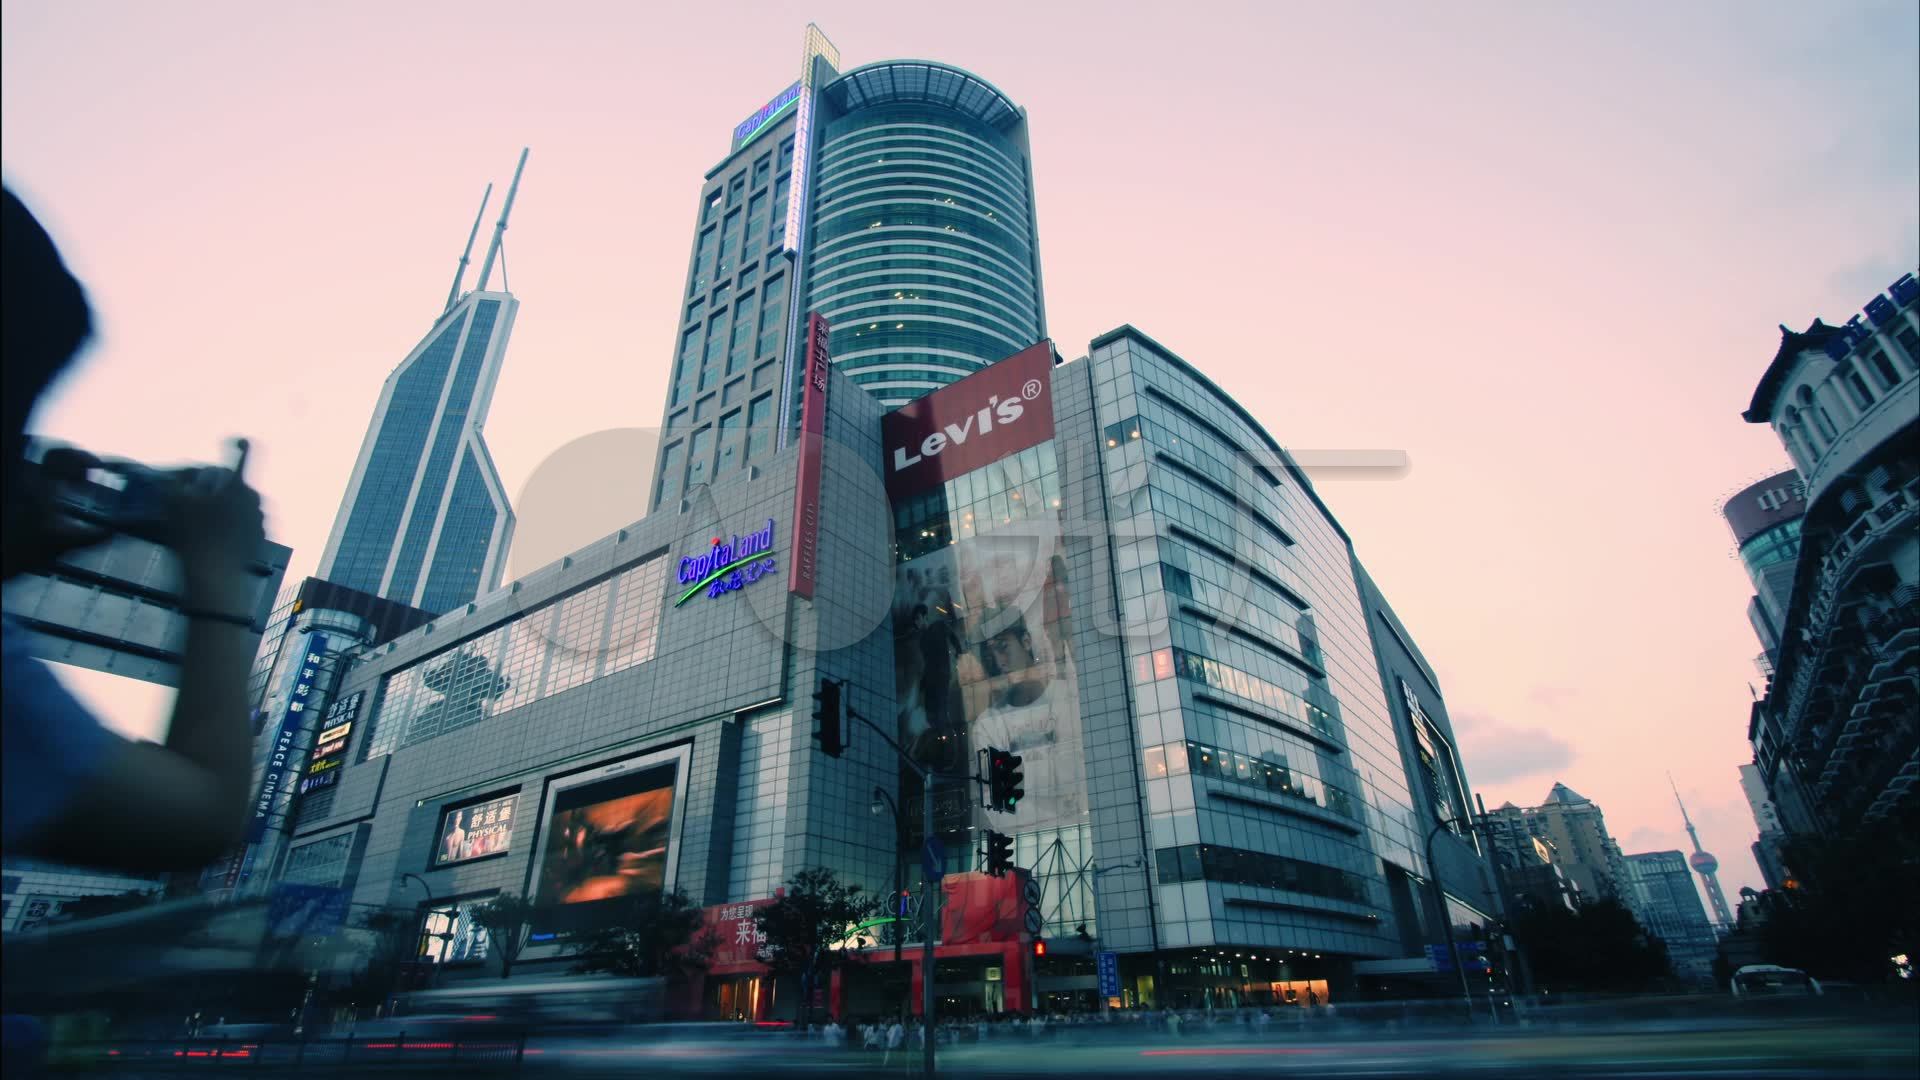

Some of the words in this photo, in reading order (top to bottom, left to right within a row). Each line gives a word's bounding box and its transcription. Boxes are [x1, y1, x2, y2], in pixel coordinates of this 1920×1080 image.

[814, 320, 830, 393] 来福士广场
[806, 503, 816, 527] CITY
[677, 518, 774, 584] CapitaLand
[803, 531, 814, 581] RAFFLES
[290, 652, 320, 713] 和平影都
[323, 710, 355, 730] PHYSICAL
[272, 730, 293, 768] PEACE
[254, 773, 279, 819] CINEMA
[467, 824, 507, 840] PHYSICAL
[470, 806, 512, 829] 舒适堡
[720, 904, 753, 921] 为您呈现
